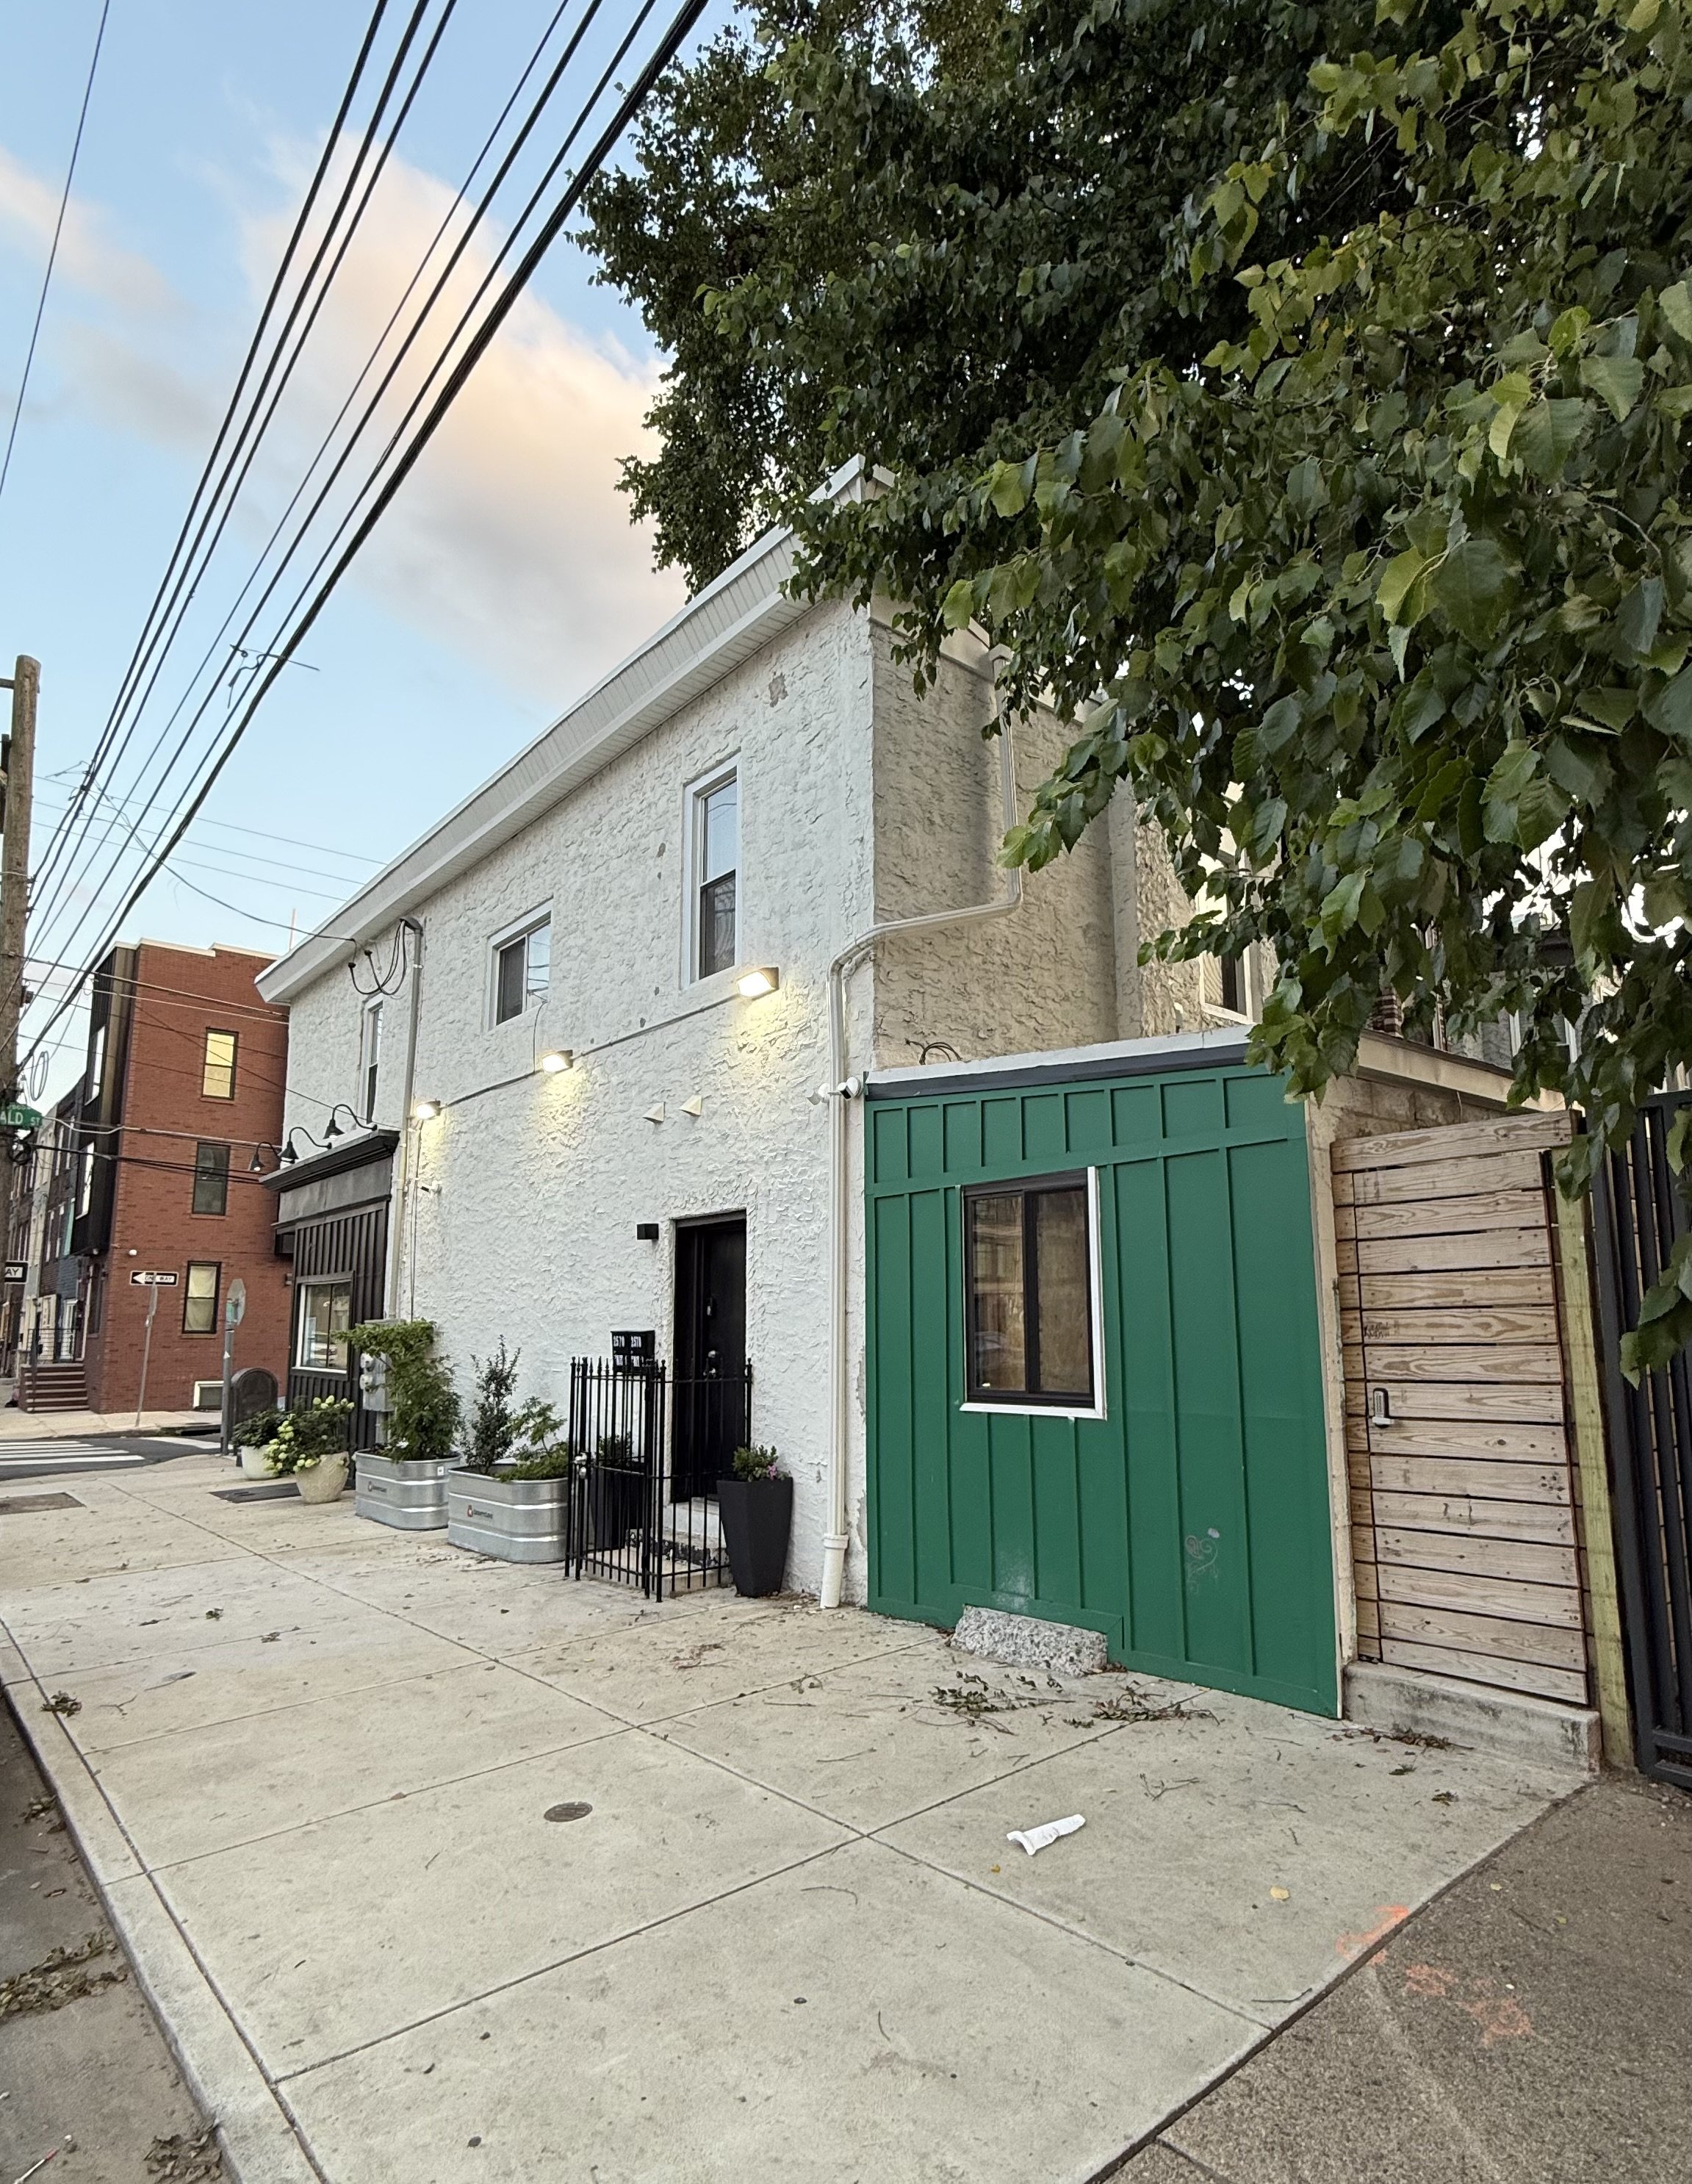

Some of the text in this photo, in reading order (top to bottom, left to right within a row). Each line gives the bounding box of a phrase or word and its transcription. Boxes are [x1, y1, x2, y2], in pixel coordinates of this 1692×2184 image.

[30, 1116, 40, 1126] ST
[4, 1268, 19, 1276] AY
[613, 1335, 624, 1347] 2570
